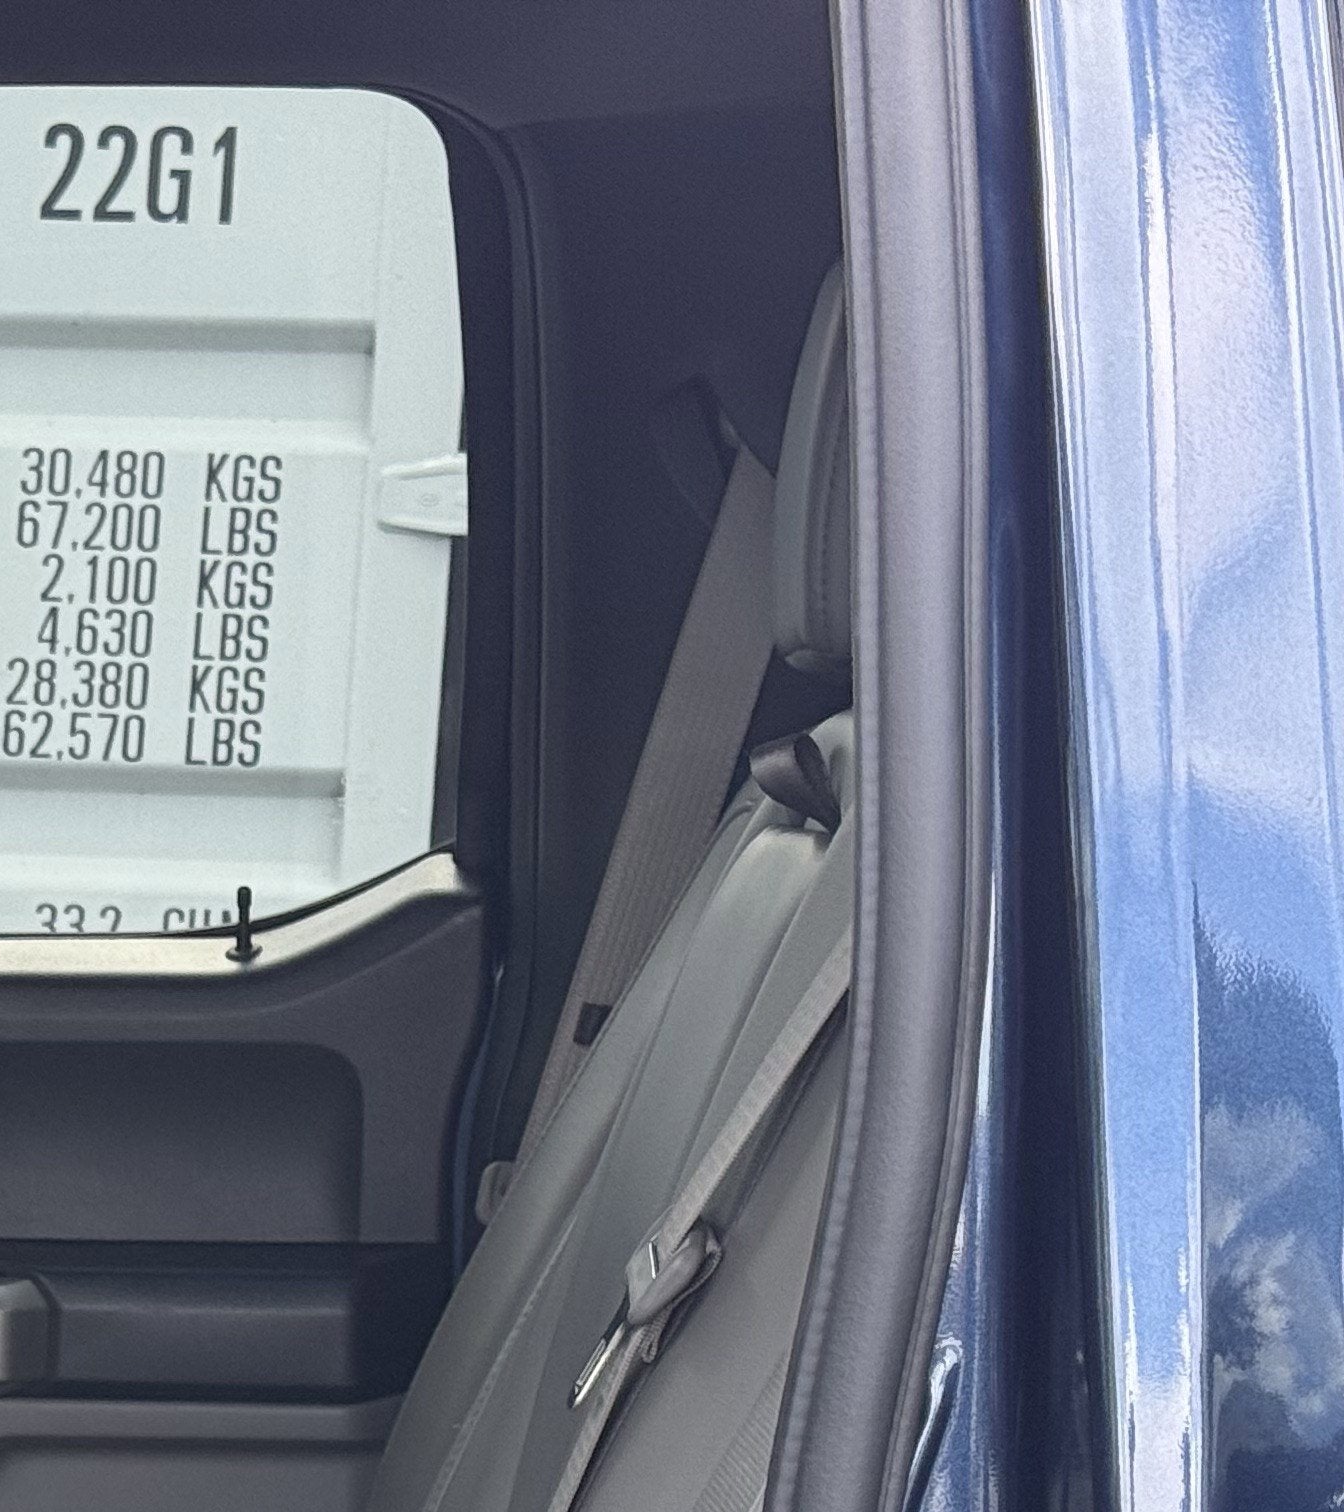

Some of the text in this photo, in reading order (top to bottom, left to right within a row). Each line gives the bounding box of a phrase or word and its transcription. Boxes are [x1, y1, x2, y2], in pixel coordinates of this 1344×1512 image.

[39, 121, 239, 226] 22G1
[203, 452, 283, 505] KGS
[199, 505, 279, 558] LBS
[196, 558, 275, 612] KGS
[191, 611, 270, 664] LBS
[187, 663, 266, 716] KGS
[184, 716, 263, 769] LBS
